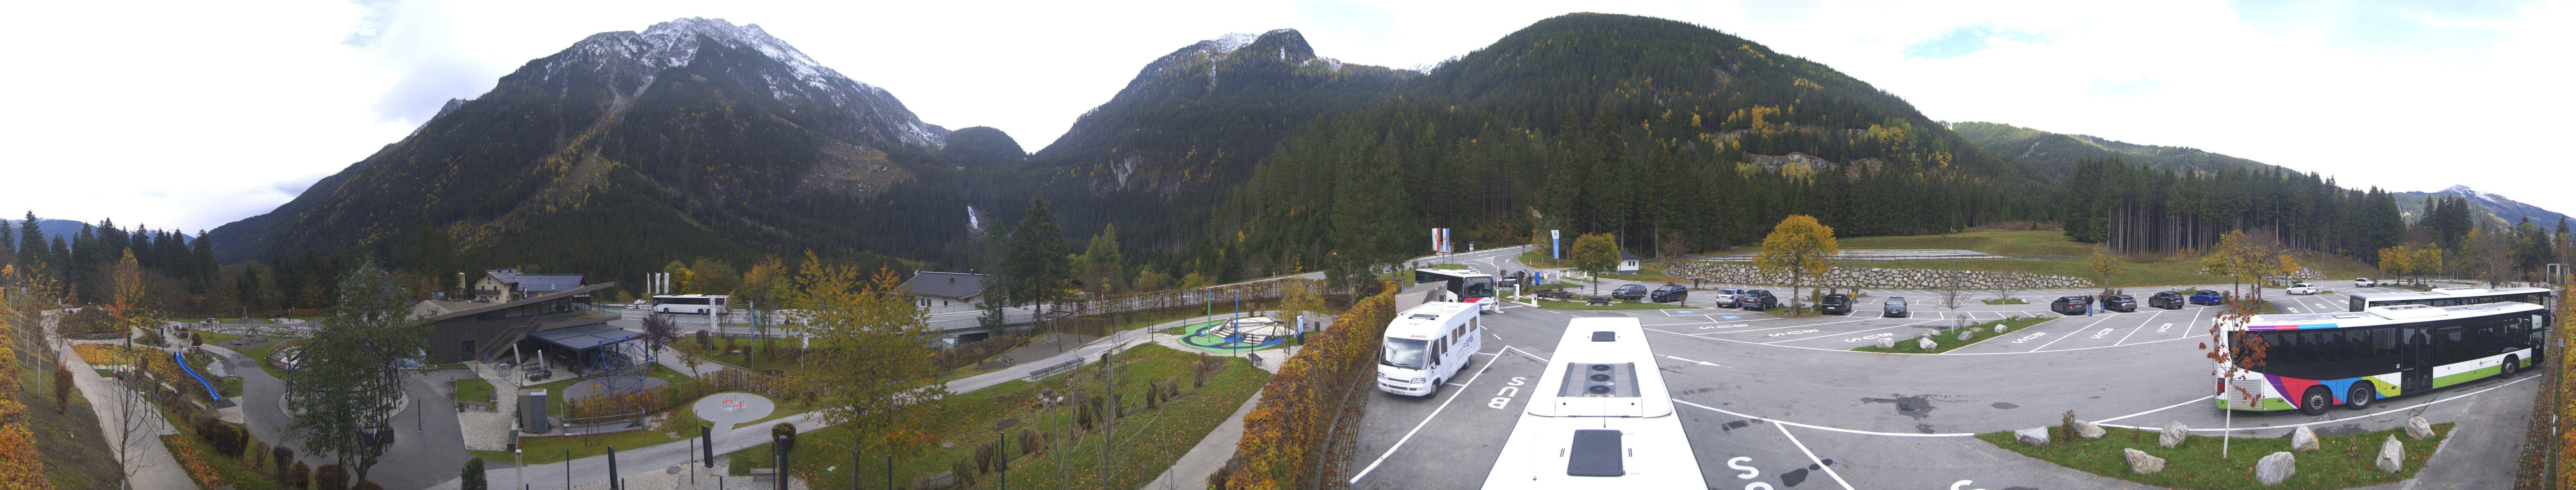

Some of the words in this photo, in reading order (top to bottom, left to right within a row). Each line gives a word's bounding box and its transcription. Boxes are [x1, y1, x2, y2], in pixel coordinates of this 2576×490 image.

[2156, 323, 2173, 332] BUS
[1844, 333, 1894, 342] BUS
[2012, 332, 2046, 343] BUS
[2090, 328, 2114, 338] BUS
[1488, 377, 1527, 409] BUS
